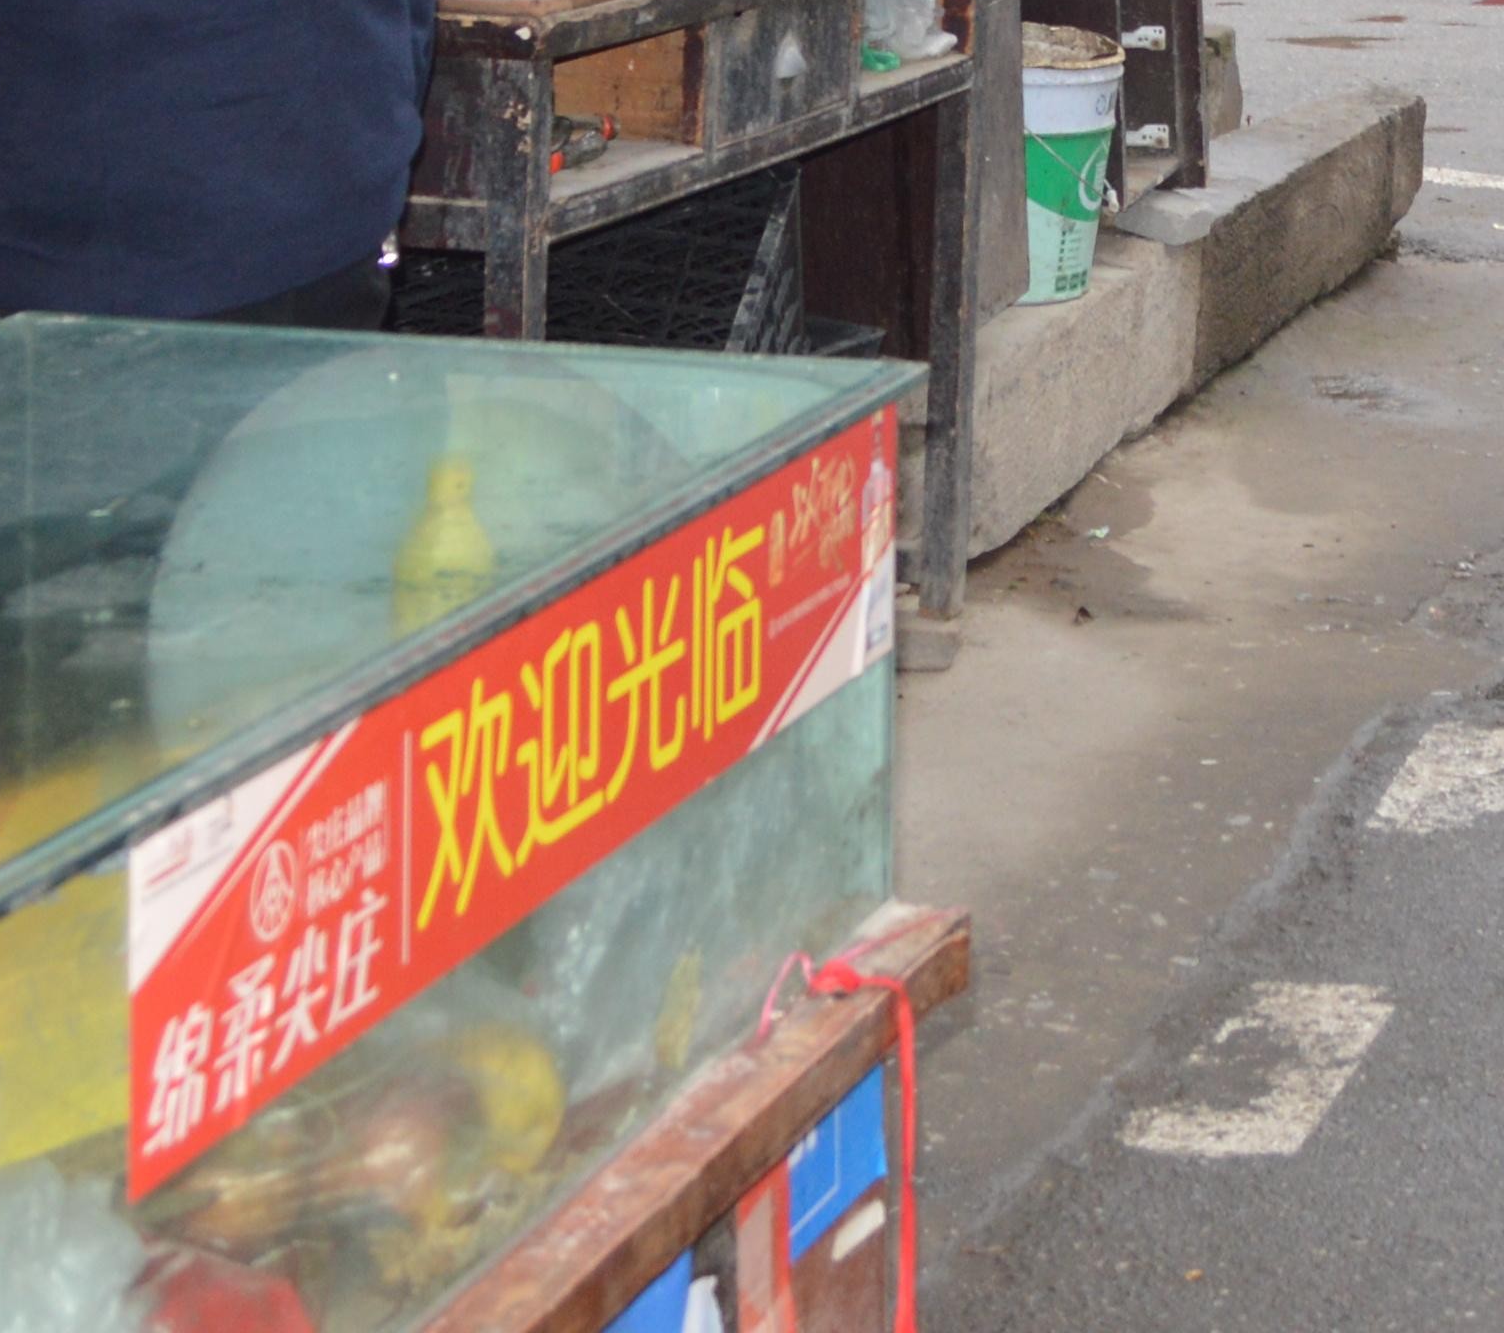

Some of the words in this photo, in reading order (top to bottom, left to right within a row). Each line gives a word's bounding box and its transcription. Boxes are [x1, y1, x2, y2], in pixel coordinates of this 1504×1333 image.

[417, 526, 766, 931] 欢迎光临
[142, 888, 388, 1158] 绵柔尖庄
